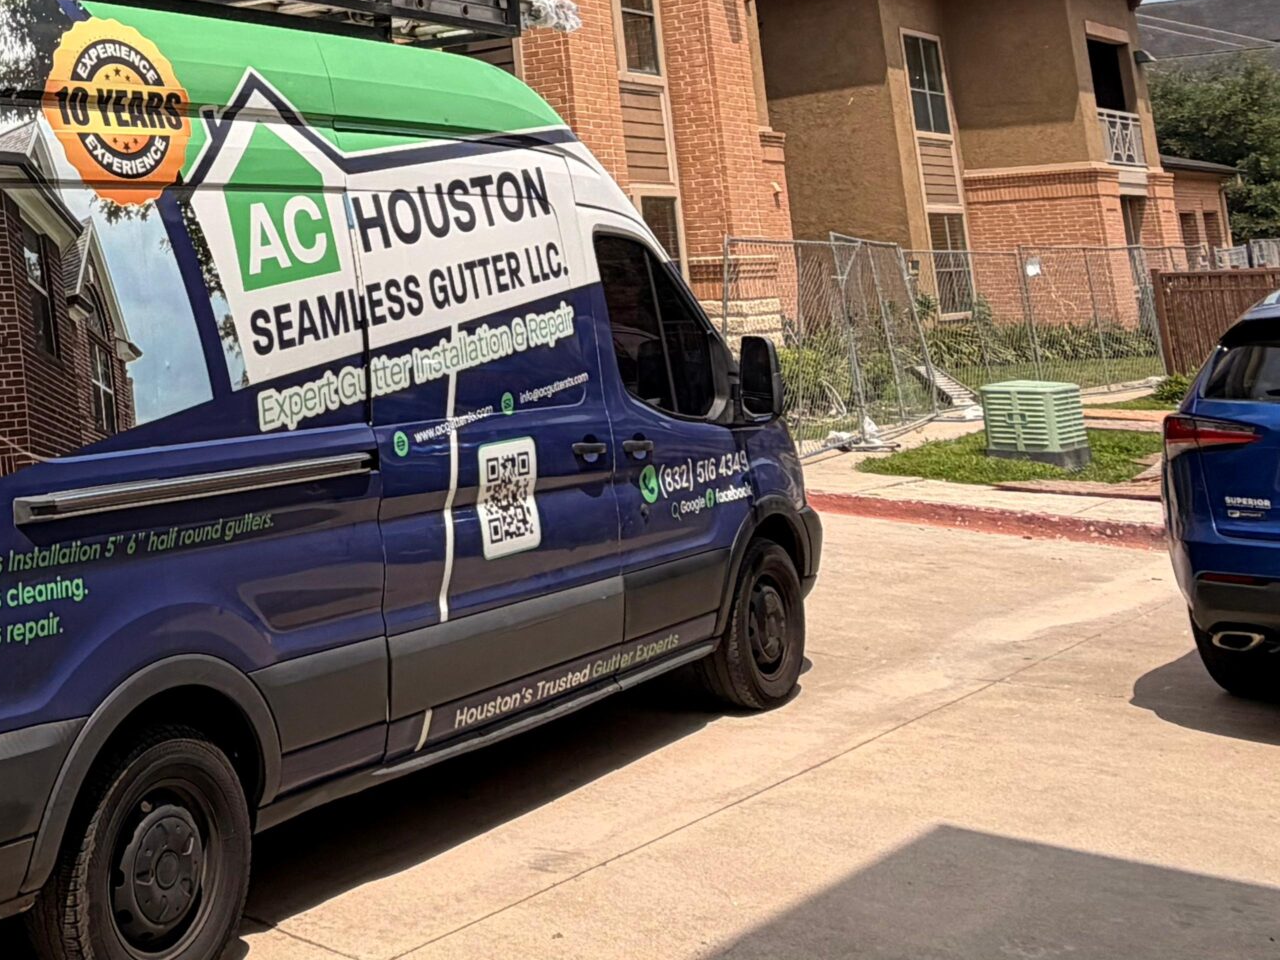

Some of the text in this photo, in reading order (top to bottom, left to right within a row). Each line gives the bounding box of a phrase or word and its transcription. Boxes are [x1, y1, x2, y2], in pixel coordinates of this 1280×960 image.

[76, 42, 158, 85] EXPERIENCE
[55, 85, 183, 131] 10 YEARS
[84, 134, 167, 175] EXPERIENCE
[249, 167, 552, 276] AC HOUSTON
[250, 241, 570, 357] SEAMLESS GUTTER LLC.
[262, 304, 574, 428] Expert Gutter Installation & Repair
[658, 449, 751, 499] (832) 516 4349
[715, 481, 753, 504] facebook
[679, 495, 706, 514] Google
[1224, 496, 1271, 507] SUPERIOR
[8, 540, 101, 572] Installation
[147, 527, 178, 552] half
[179, 518, 223, 546] round
[224, 512, 275, 541] gutters.
[6, 575, 89, 607] cleaning.
[6, 611, 64, 646] repair.
[454, 632, 680, 729] Houston's Trusted Gutter Experts
